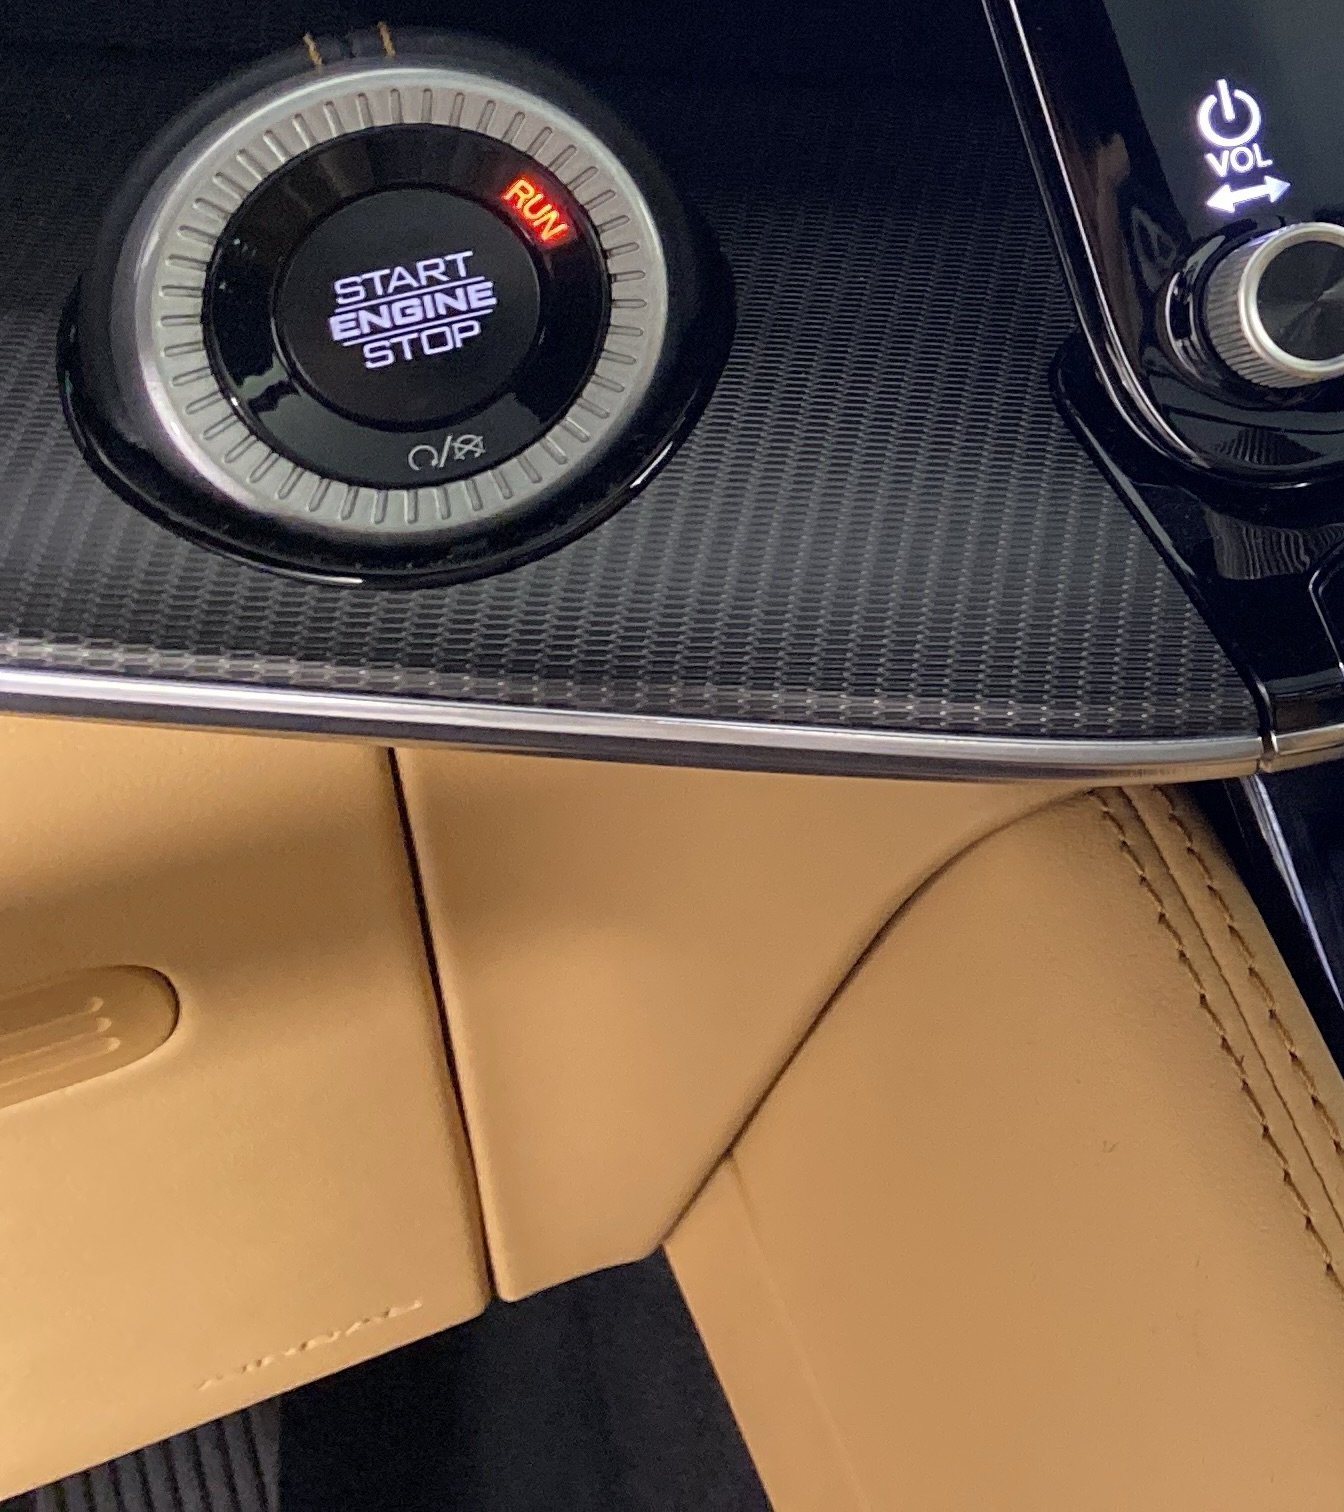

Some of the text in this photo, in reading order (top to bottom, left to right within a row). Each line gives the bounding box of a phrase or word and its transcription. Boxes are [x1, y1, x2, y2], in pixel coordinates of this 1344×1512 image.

[1205, 143, 1273, 177] VOL
[504, 177, 568, 243] RUN
[334, 251, 474, 305] START
[329, 280, 497, 343] ENGINE
[363, 319, 481, 370] STOP
